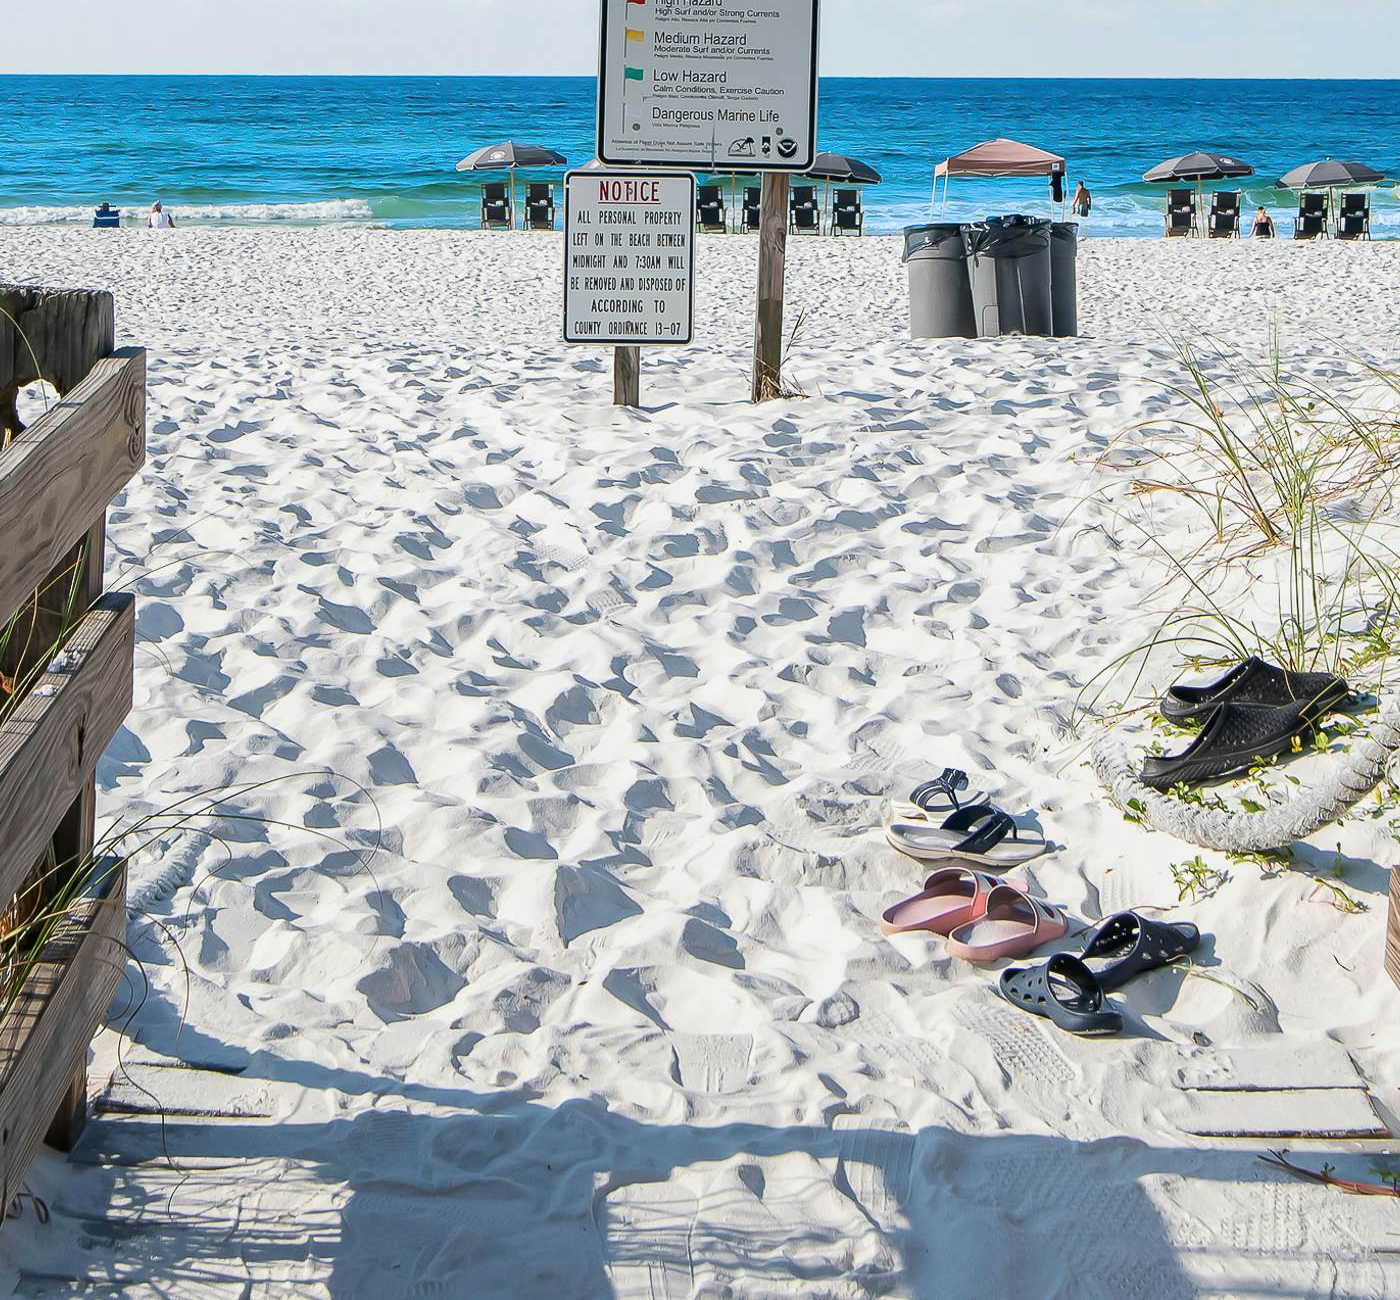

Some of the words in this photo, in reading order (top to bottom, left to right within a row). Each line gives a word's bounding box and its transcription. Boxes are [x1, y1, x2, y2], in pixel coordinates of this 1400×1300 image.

[655, 8, 672, 16] High
[675, 8, 692, 16] Surf
[693, 8, 717, 16] and/or
[719, 9, 744, 19] Strong
[747, 10, 780, 18] Currents
[654, 32, 700, 44] Medium
[704, 33, 747, 45] Hazard
[654, 45, 690, 53] Moderate
[693, 45, 708, 53] Surf
[711, 46, 736, 54] and/or
[738, 47, 770, 55] Currents
[653, 69, 679, 82] Low
[682, 70, 727, 83] Hazard
[653, 85, 673, 93] Calm
[755, 87, 784, 95] Caution
[652, 107, 714, 123] Dangerous
[718, 109, 756, 122] Marine
[760, 109, 780, 122] Life
[600, 181, 660, 201] NOTICE
[578, 211, 591, 224] ALL
[599, 211, 636, 224] PERSONAL
[645, 212, 682, 225] PROPERTY
[573, 233, 588, 246] LEFT
[595, 233, 604, 246] ON
[611, 233, 622, 246] THE
[630, 234, 650, 246] BEACH
[657, 234, 685, 247] BETWEEN
[573, 255, 606, 268] MIDNIGHT
[613, 256, 628, 268] AND
[636, 256, 660, 269] 7:30AM
[668, 256, 684, 269] WILL
[570, 277, 579, 290] BE
[585, 277, 616, 290] REMOVED
[620, 278, 634, 290] AND
[639, 278, 672, 291] DISPOSED
[676, 278, 686, 291] OF
[591, 299, 643, 313] ACCORDING
[654, 300, 666, 313] TO
[575, 322, 601, 335] COUNTY
[656, 322, 681, 335] 13-07
